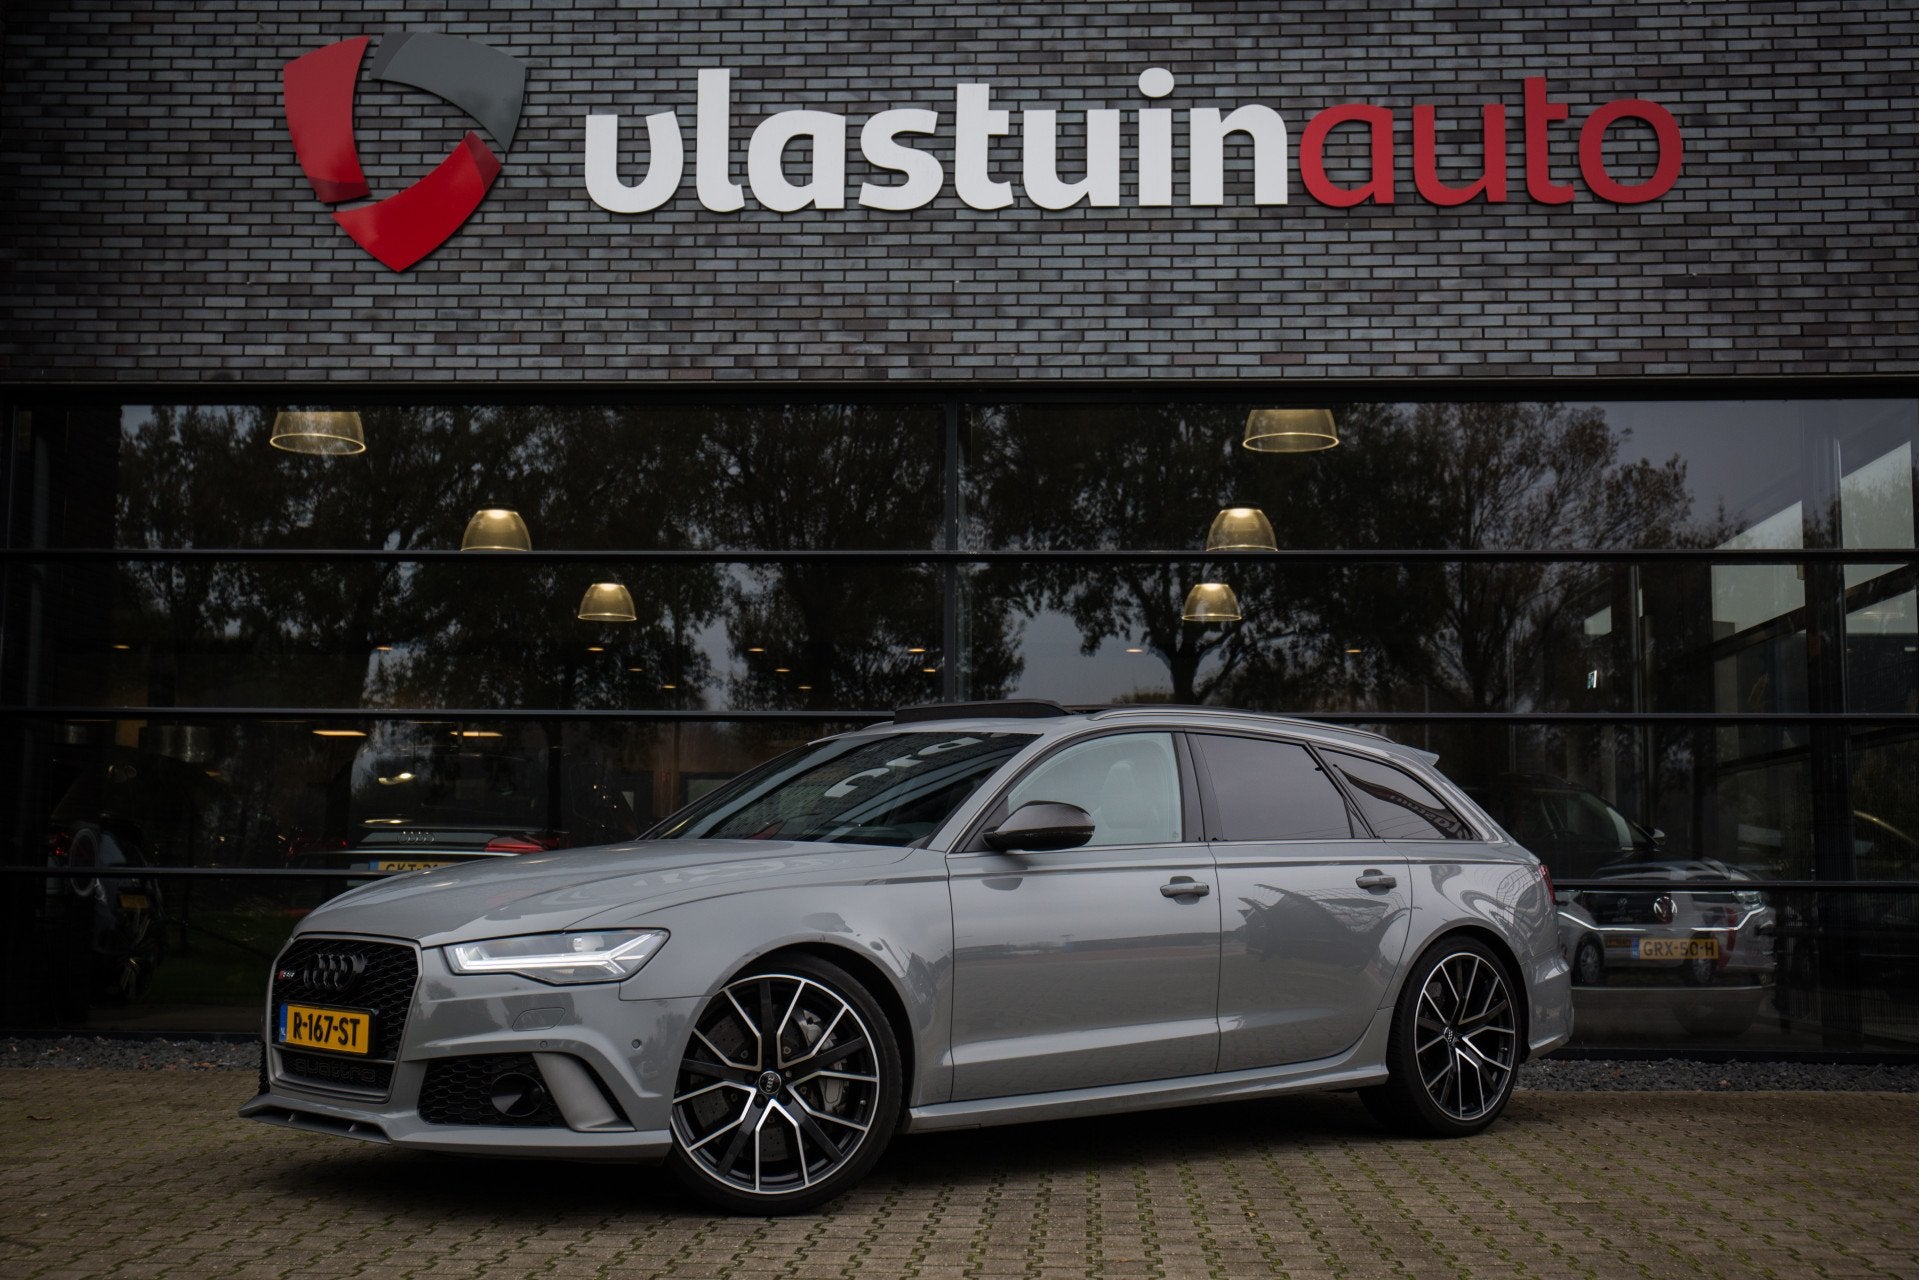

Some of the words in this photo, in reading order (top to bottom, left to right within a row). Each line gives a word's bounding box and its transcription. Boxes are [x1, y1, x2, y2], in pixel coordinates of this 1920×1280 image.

[1644, 941, 1714, 956] GRX-50-H
[293, 1012, 360, 1047] R-167-ST
[295, 1057, 374, 1080] quattro
